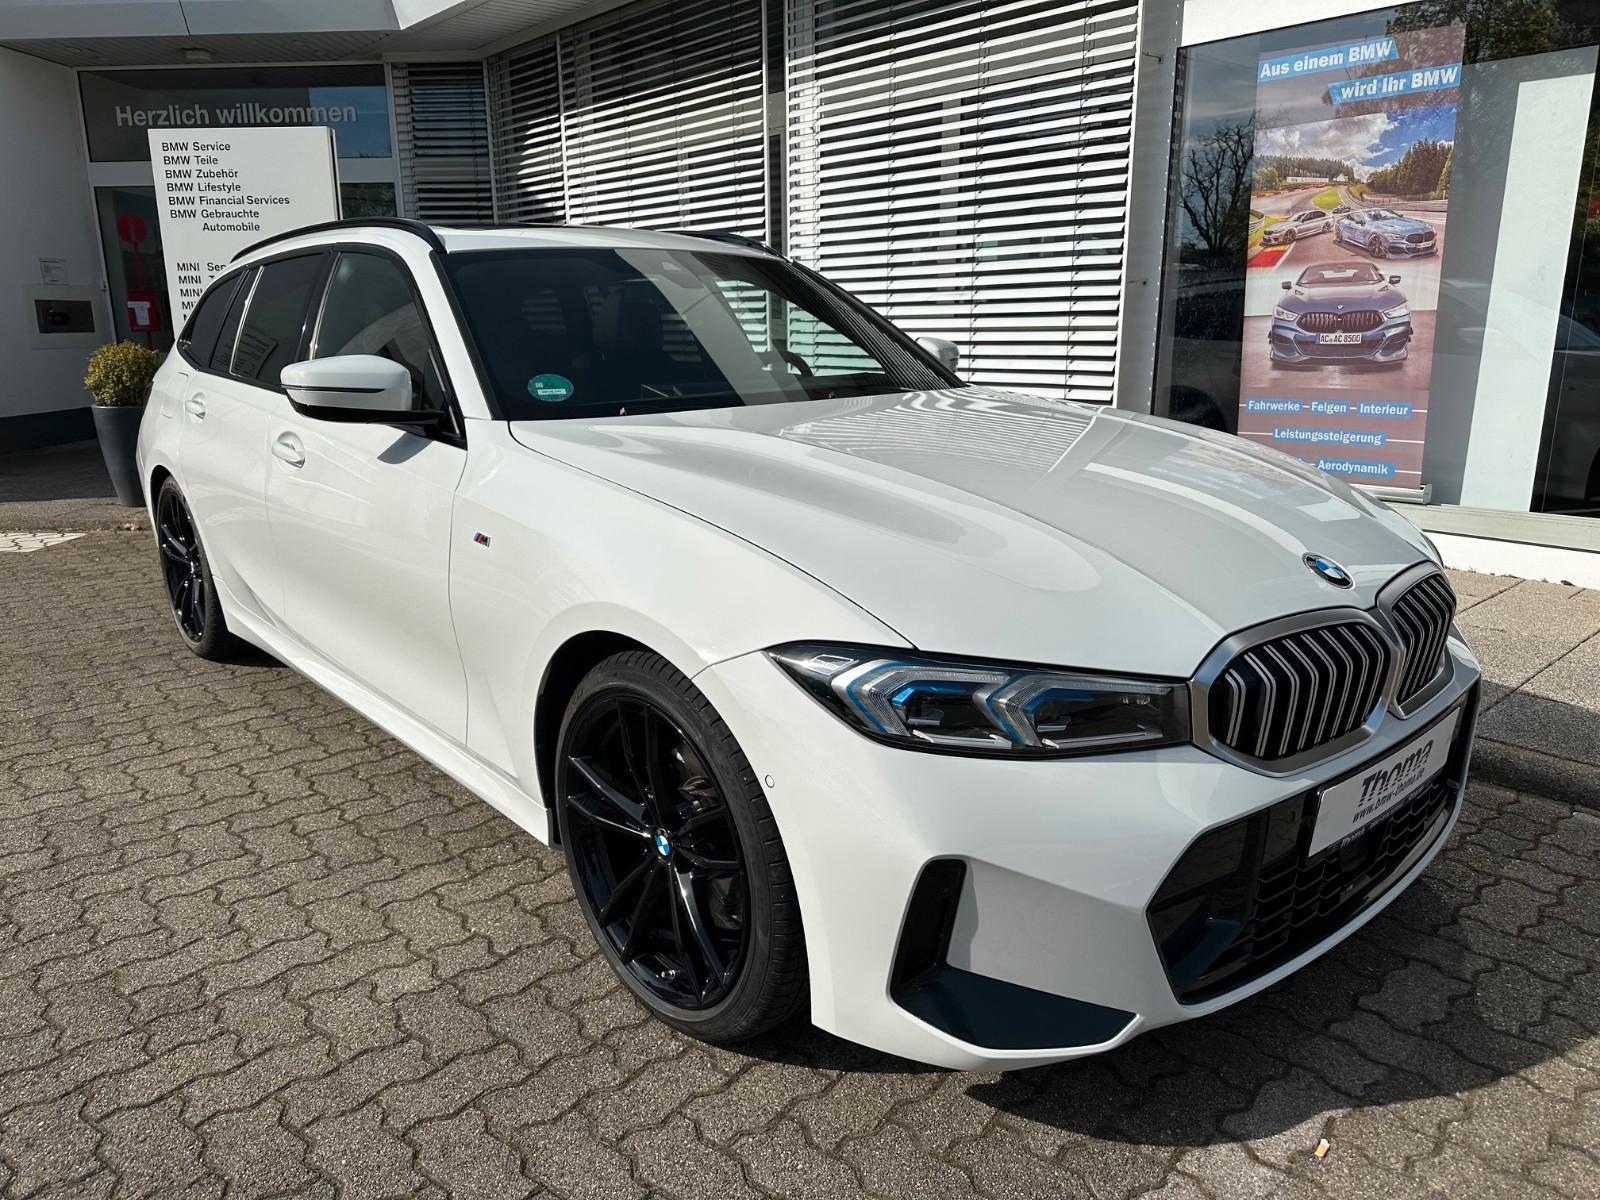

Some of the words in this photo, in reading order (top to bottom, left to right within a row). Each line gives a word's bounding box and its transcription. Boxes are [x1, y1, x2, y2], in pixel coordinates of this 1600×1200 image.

[1260, 63, 1290, 79] Aus
[1293, 52, 1344, 73] einem
[1348, 40, 1393, 62] BMW
[1340, 79, 1378, 99] wird
[1381, 75, 1408, 93] Ihr
[1411, 67, 1458, 88] BMW
[115, 103, 210, 127] Herzlich
[215, 103, 358, 125] willkommen
[161, 142, 189, 151] BMW
[192, 141, 231, 151] Service
[163, 155, 191, 165] BMW
[194, 155, 219, 165] Teile
[165, 169, 192, 179] BMW
[195, 168, 239, 179] Zubehör
[166, 182, 194, 192] BMW
[197, 182, 241, 193] Lifestyle
[168, 196, 195, 206] BMW
[199, 195, 245, 205] Financial
[246, 195, 290, 205] Services
[170, 209, 197, 219] BMW
[201, 209, 260, 219] Gebrauchte
[202, 222, 261, 232] Automobile
[176, 262, 200, 272] MINI
[178, 275, 202, 285] MINI
[1247, 401, 1301, 412] Fahrwerke
[1310, 402, 1347, 414] Felgen
[1359, 403, 1409, 416] Interieur
[1274, 428, 1382, 446] Leistungssteigerung
[1317, 459, 1389, 475] Aerodynamik
[1357, 739, 1434, 808] Thoma
